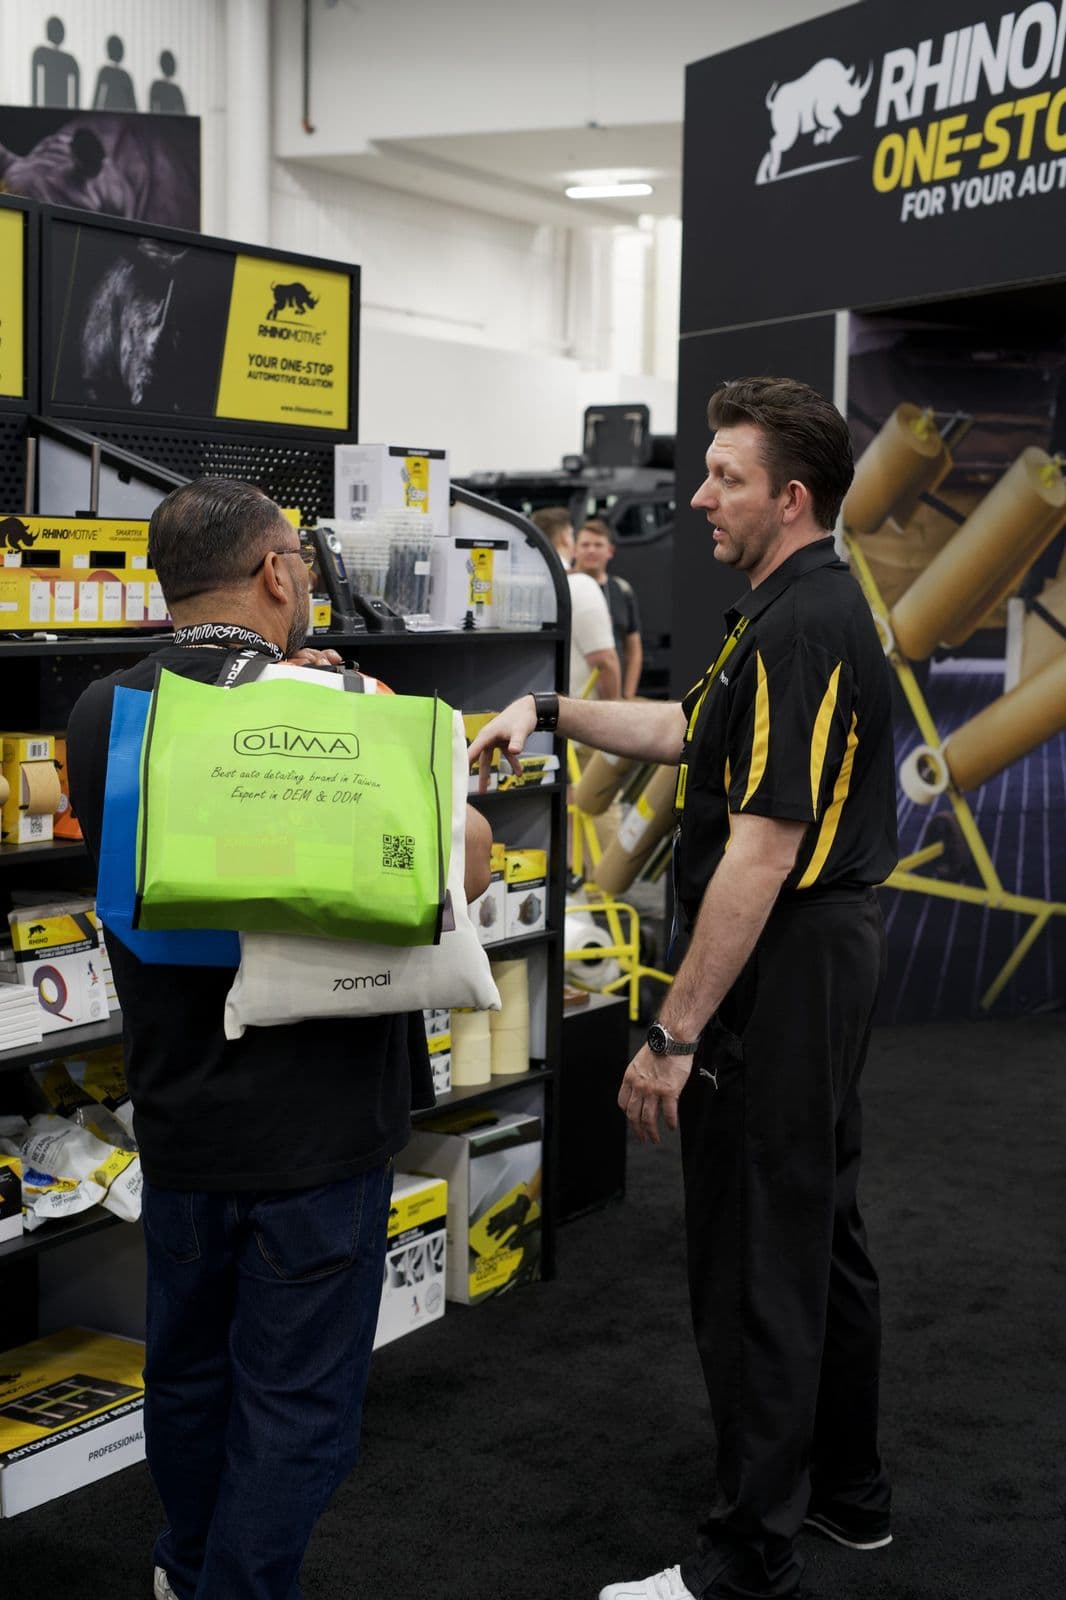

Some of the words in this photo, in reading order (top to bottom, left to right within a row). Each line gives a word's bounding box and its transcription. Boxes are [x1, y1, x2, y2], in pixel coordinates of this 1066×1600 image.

[900, 186, 946, 223] FOR
[951, 170, 1015, 212] YOUR
[248, 353, 278, 369] YOUR
[280, 358, 334, 376] ONE-STOP
[247, 370, 296, 385] AUTOMOTIVE
[298, 377, 333, 389] SOLUTION
[243, 731, 351, 754] OLIMA
[210, 766, 237, 778] Best
[239, 769, 261, 779] auto
[263, 768, 304, 785] detailing
[309, 773, 336, 784] brand
[340, 774, 348, 784] in
[352, 773, 381, 788] Taiwan
[231, 785, 266, 802] Expert
[269, 790, 278, 800] in
[282, 788, 311, 801] OEM
[316, 790, 327, 802] &
[331, 792, 363, 804] ODM
[333, 971, 391, 991] 70mai
[7, 1424, 82, 1460] AUTOMOTIVE
[81, 1413, 111, 1430] BODY
[88, 1431, 144, 1462] PROFESSIONAL
